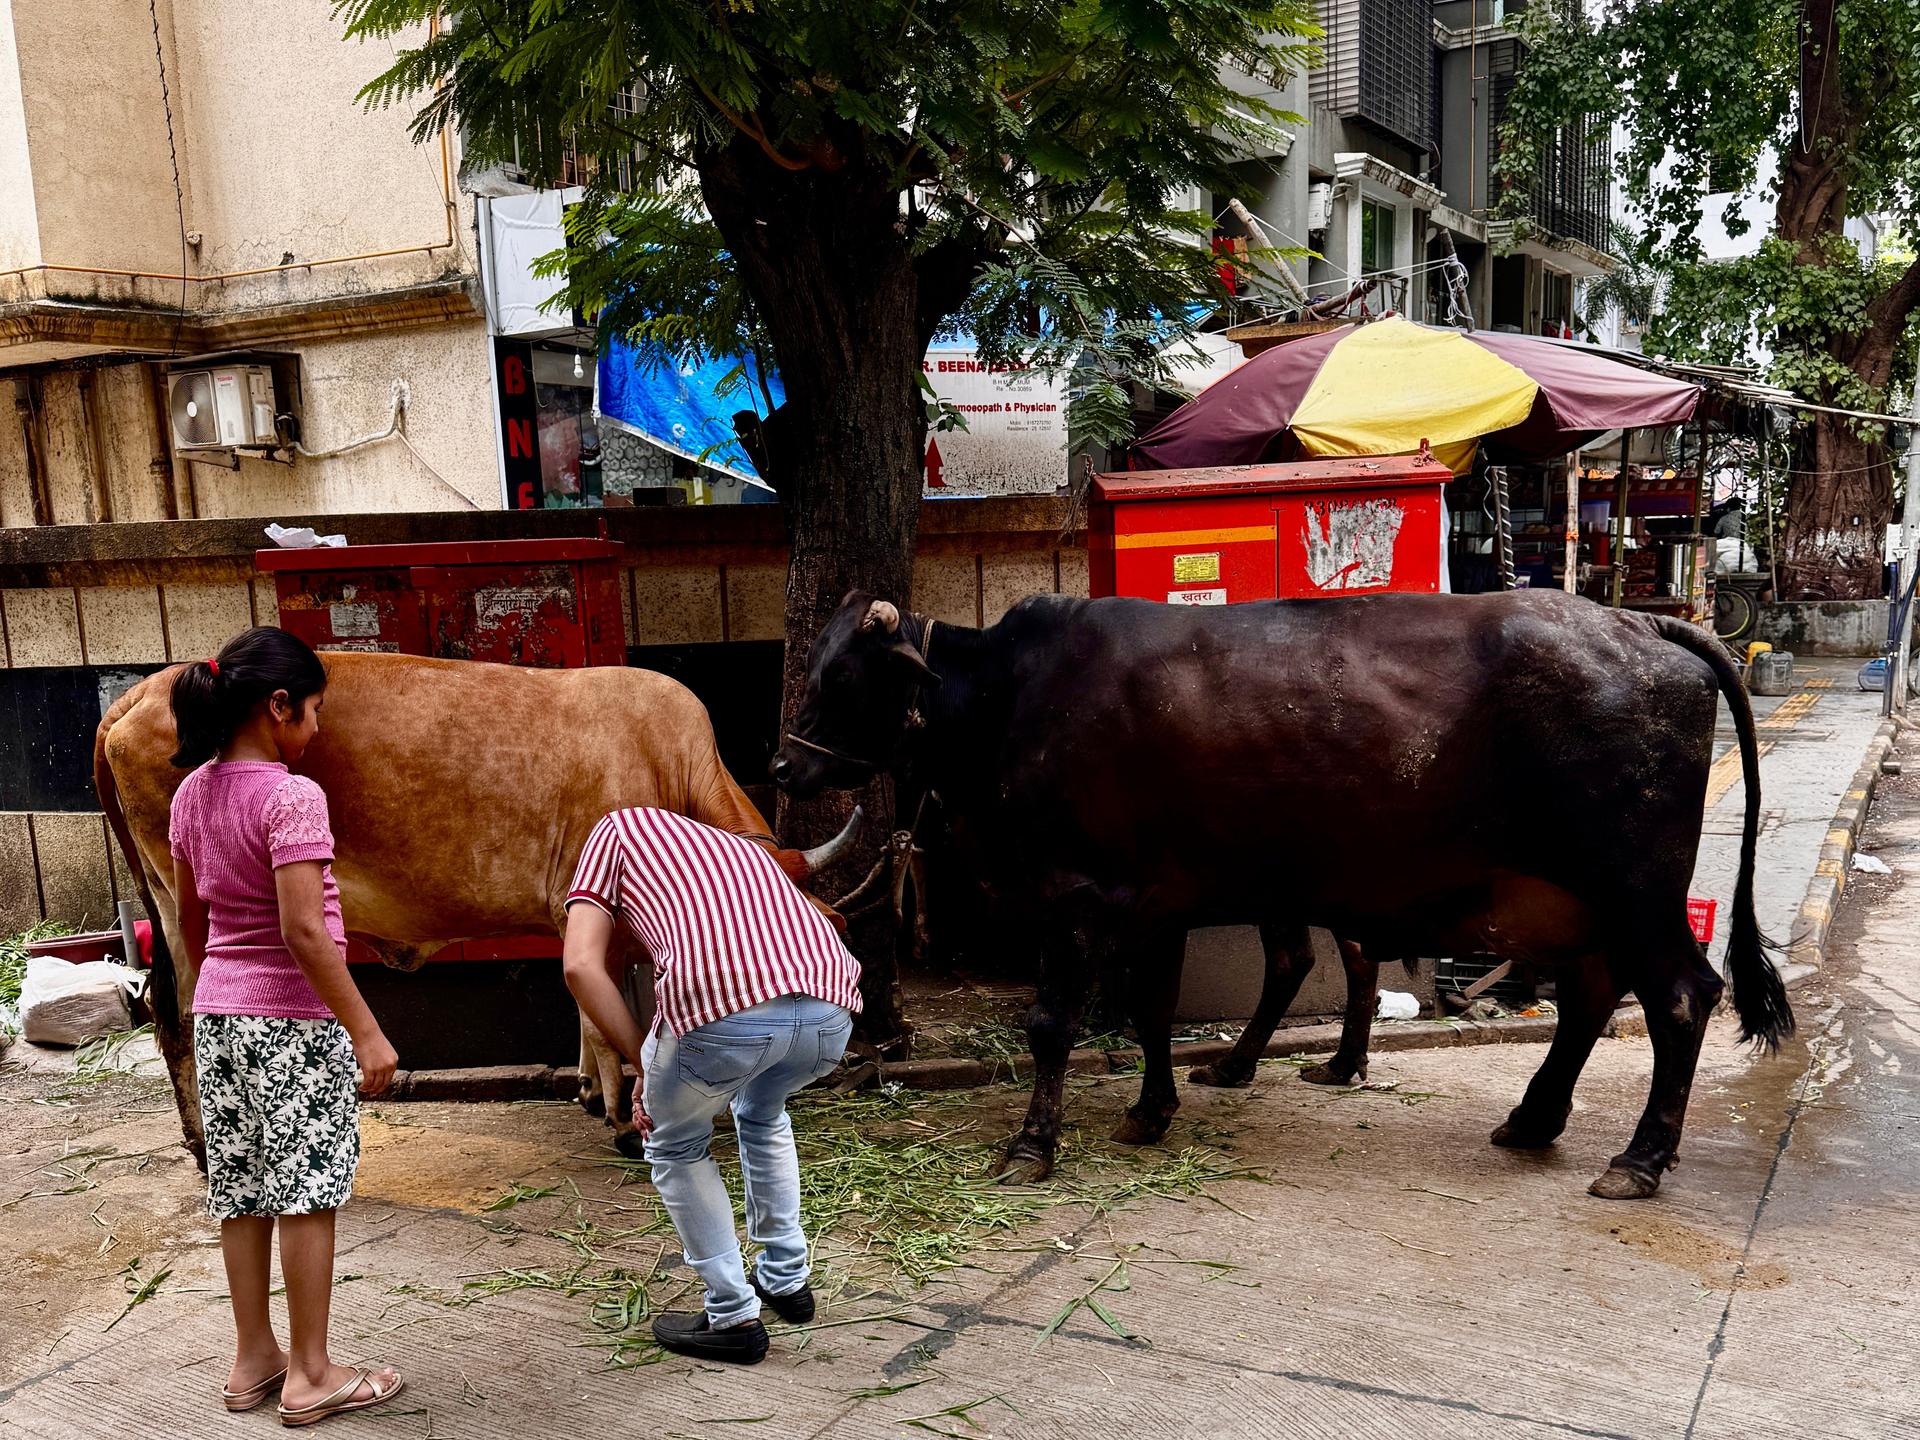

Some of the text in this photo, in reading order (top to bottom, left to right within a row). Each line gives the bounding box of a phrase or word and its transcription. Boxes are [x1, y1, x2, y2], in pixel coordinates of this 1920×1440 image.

[921, 360, 934, 373] R.
[938, 360, 985, 372] BEENA
[1005, 403, 1011, 412] &
[1013, 402, 1057, 414] Physician
[1181, 592, 1213, 602] खतरा
